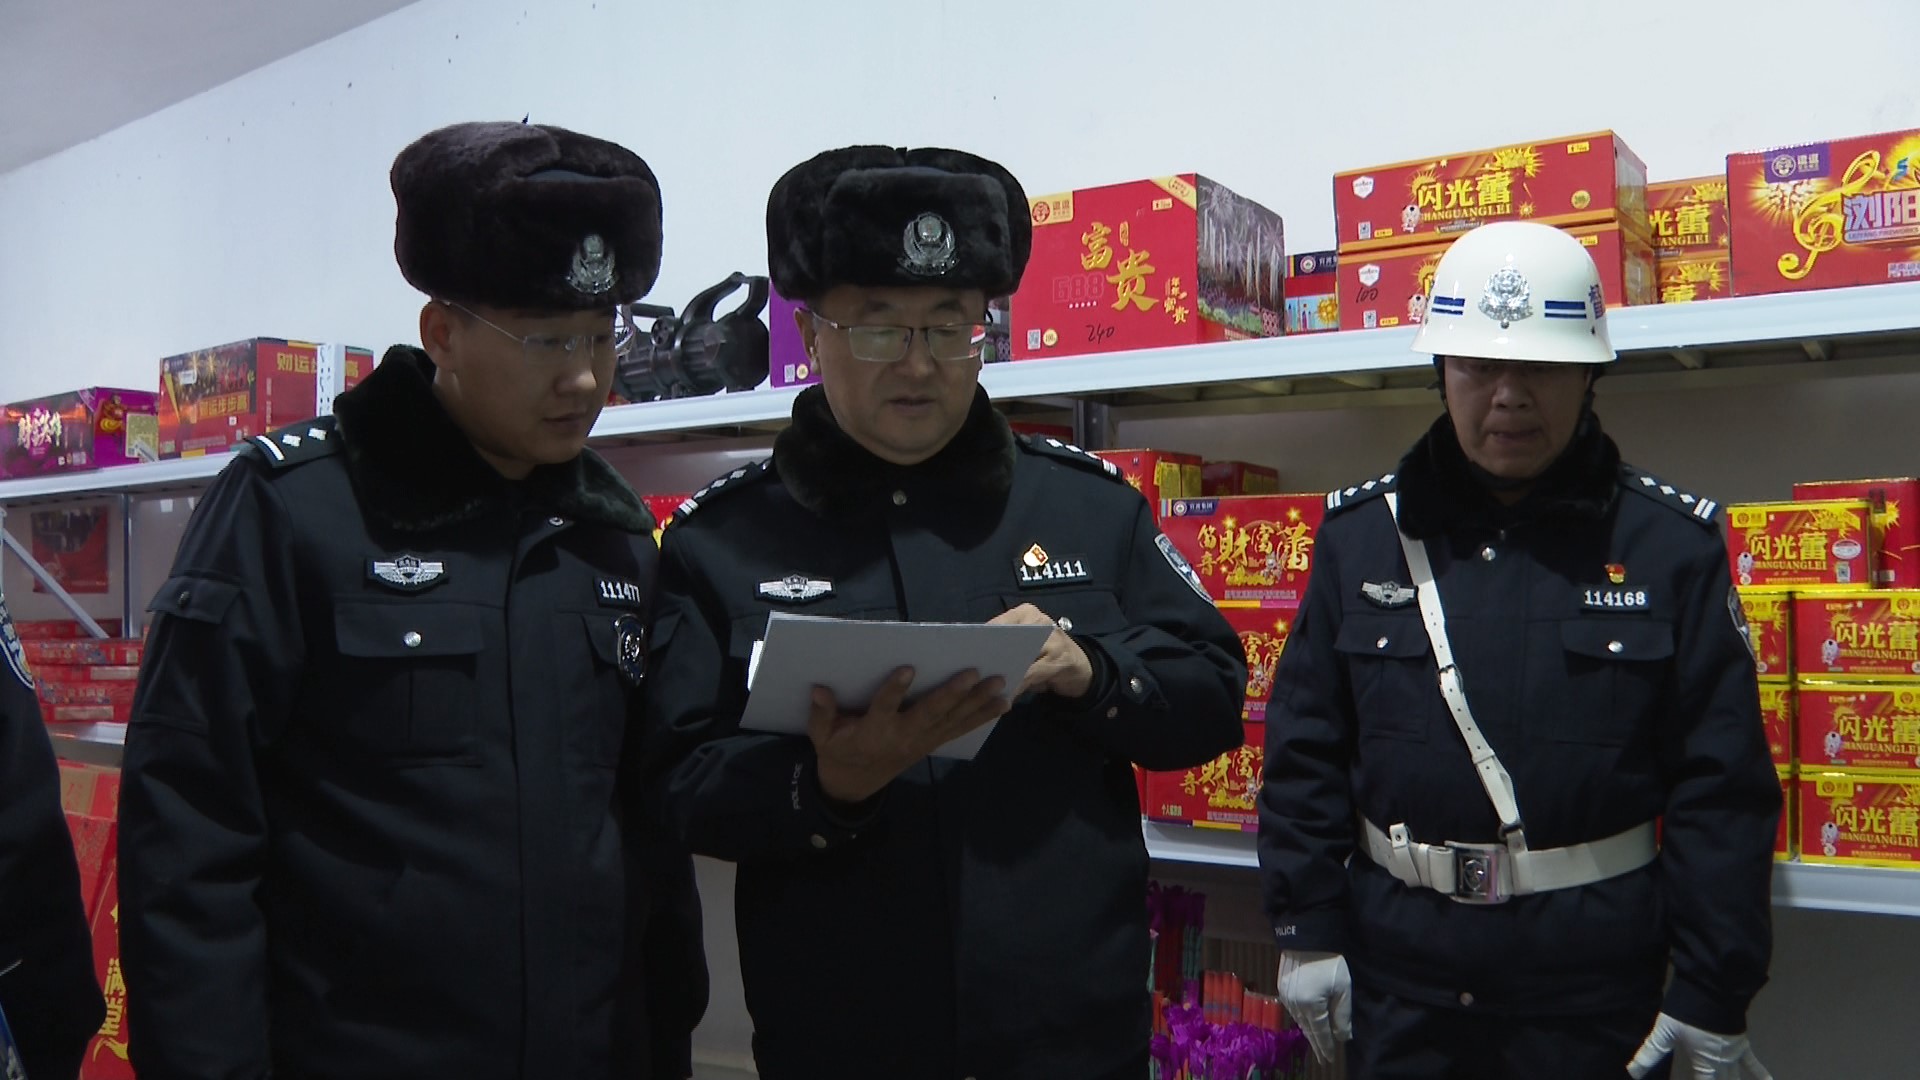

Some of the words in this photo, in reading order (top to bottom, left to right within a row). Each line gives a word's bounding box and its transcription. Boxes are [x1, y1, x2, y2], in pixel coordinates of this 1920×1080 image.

[1417, 171, 1512, 211] 闪光蕾
[1649, 203, 1710, 236] 光蕾
[1843, 191, 1920, 231] 浏阳
[1356, 287, 1379, 304] 100
[1086, 323, 1116, 345] 240
[1750, 532, 1828, 560] 闪光蕾
[600, 580, 640, 603] 111477
[1584, 590, 1646, 606] 114168
[1836, 621, 1919, 649] 闪光蕾
[1839, 715, 1920, 745] 闪光蕾
[1836, 807, 1919, 836] 闪光蕾
